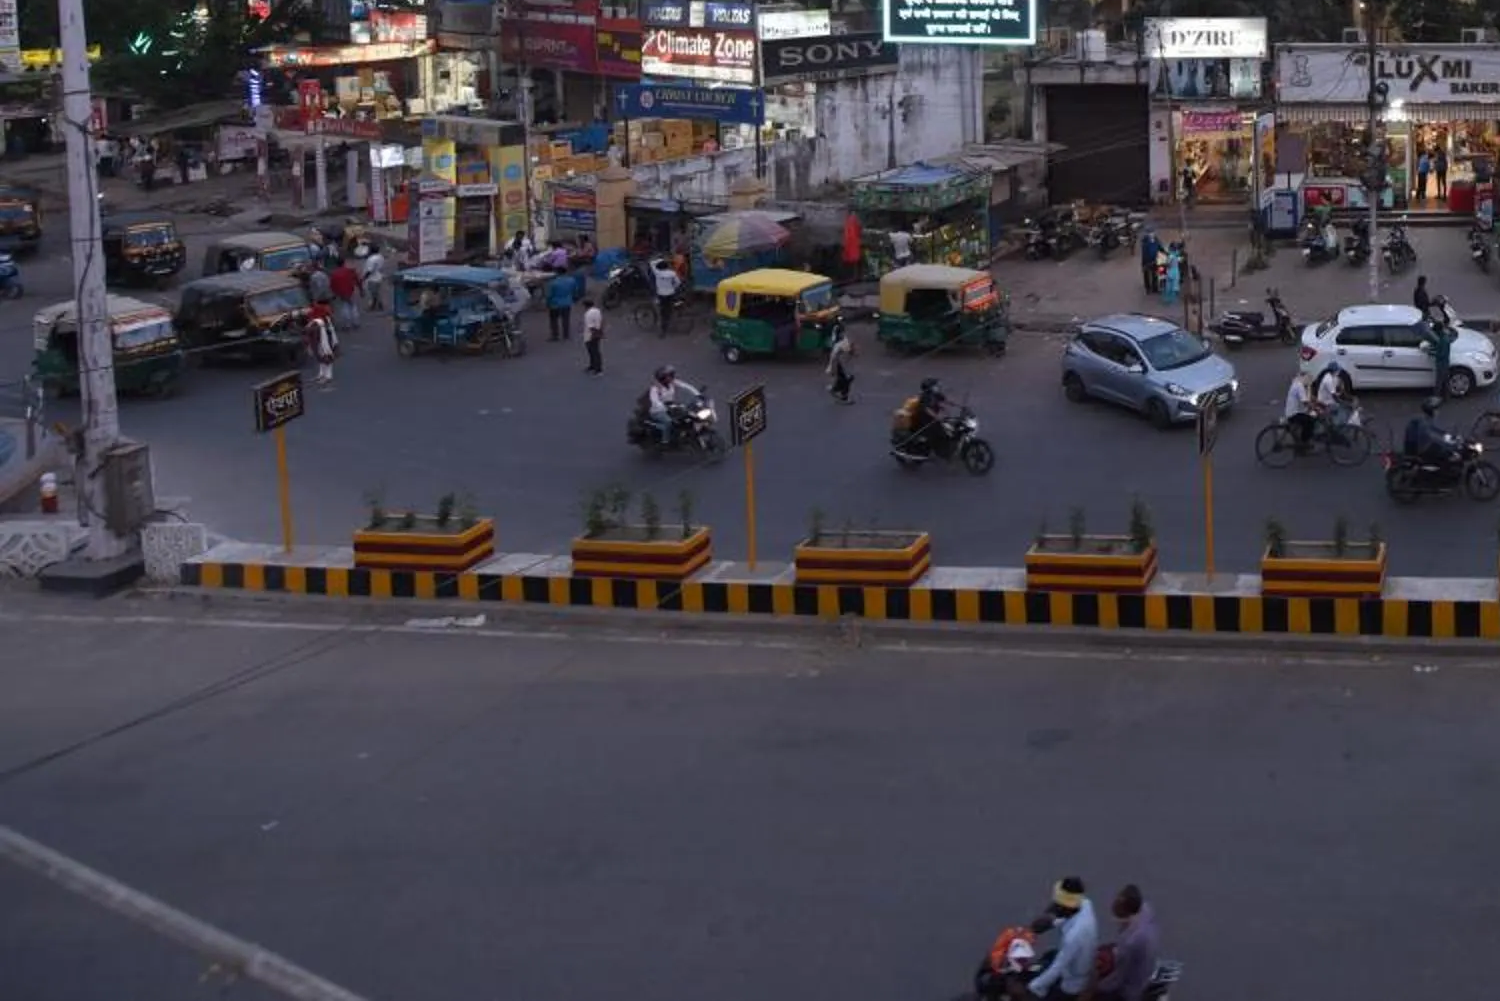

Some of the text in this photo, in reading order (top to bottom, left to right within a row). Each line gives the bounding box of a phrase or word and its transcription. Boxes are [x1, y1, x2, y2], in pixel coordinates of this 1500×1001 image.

[712, 7, 751, 24] VOLTAS
[657, 30, 711, 56] Climate
[714, 33, 754, 58] Zone
[779, 40, 882, 66] SONY
[1377, 54, 1472, 91] LUXMI
